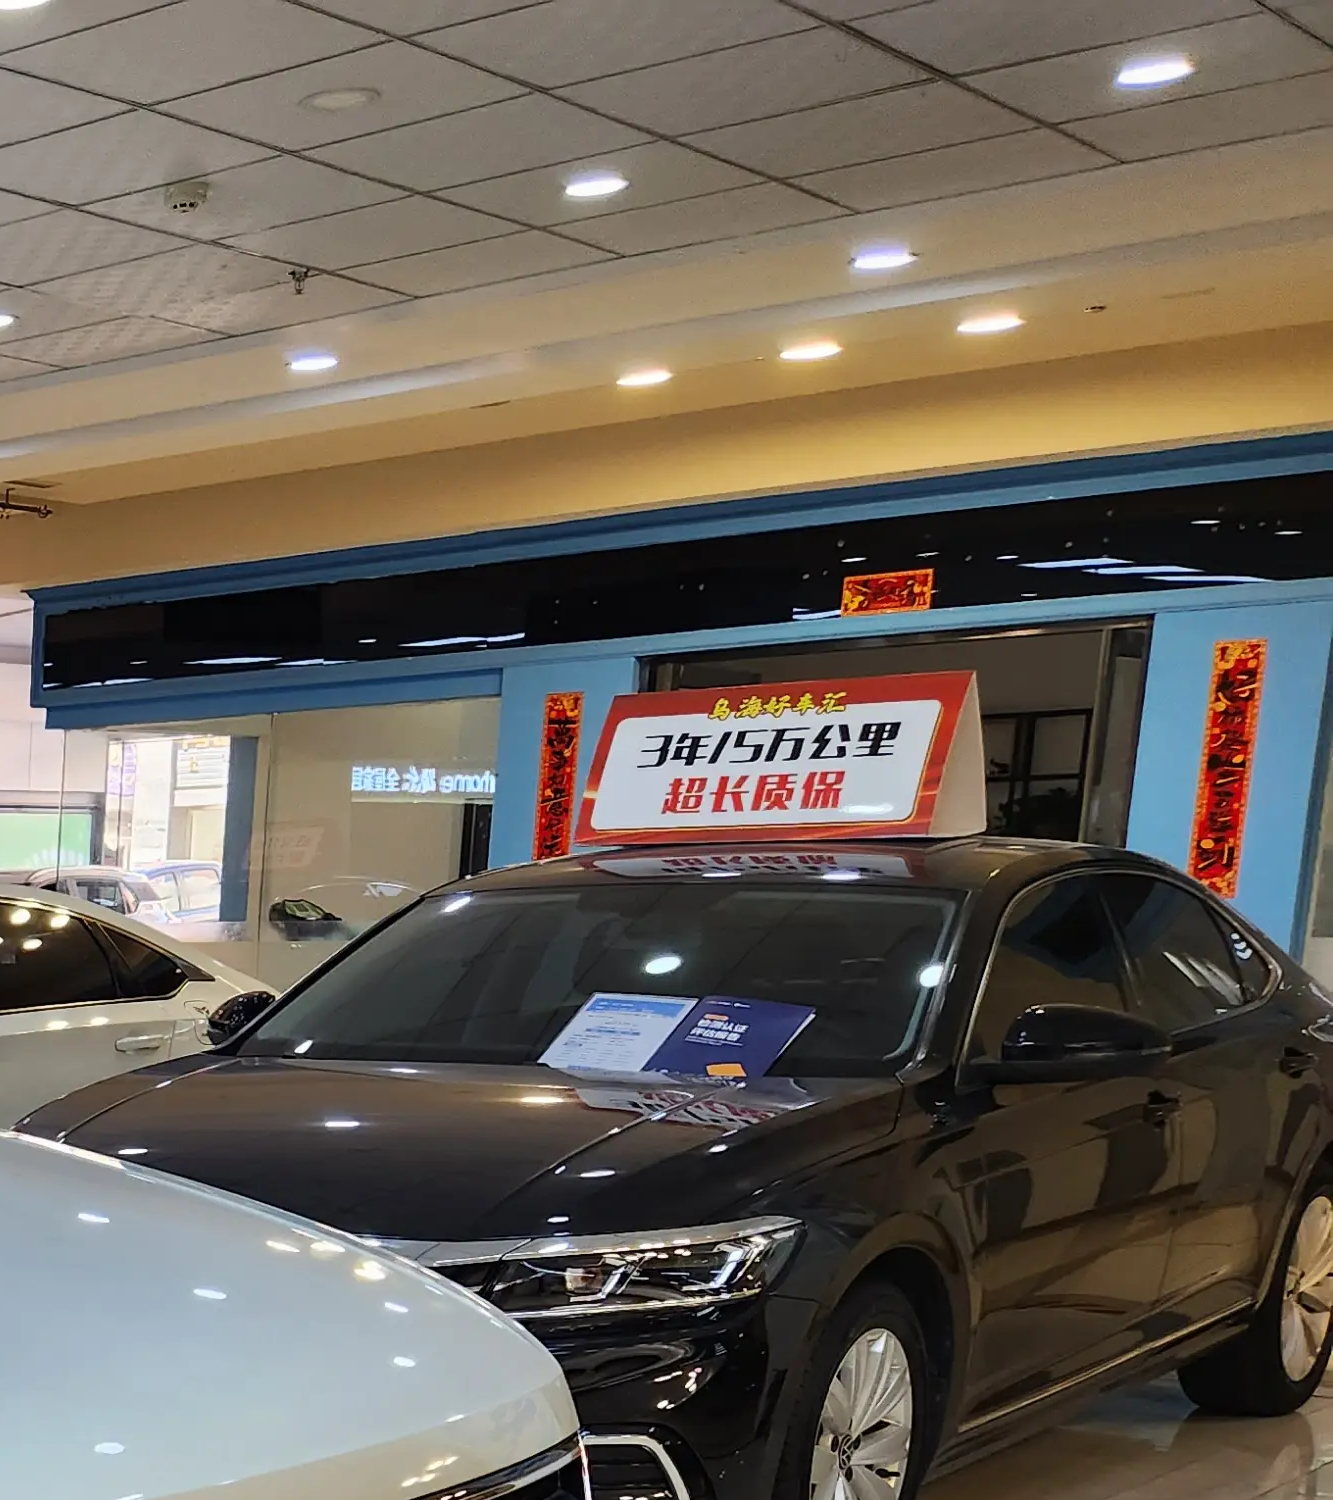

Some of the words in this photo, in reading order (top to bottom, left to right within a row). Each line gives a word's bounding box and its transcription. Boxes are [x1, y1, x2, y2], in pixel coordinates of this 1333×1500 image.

[708, 691, 847, 720] 乌海好车汇
[661, 770, 846, 814] 超长质保
